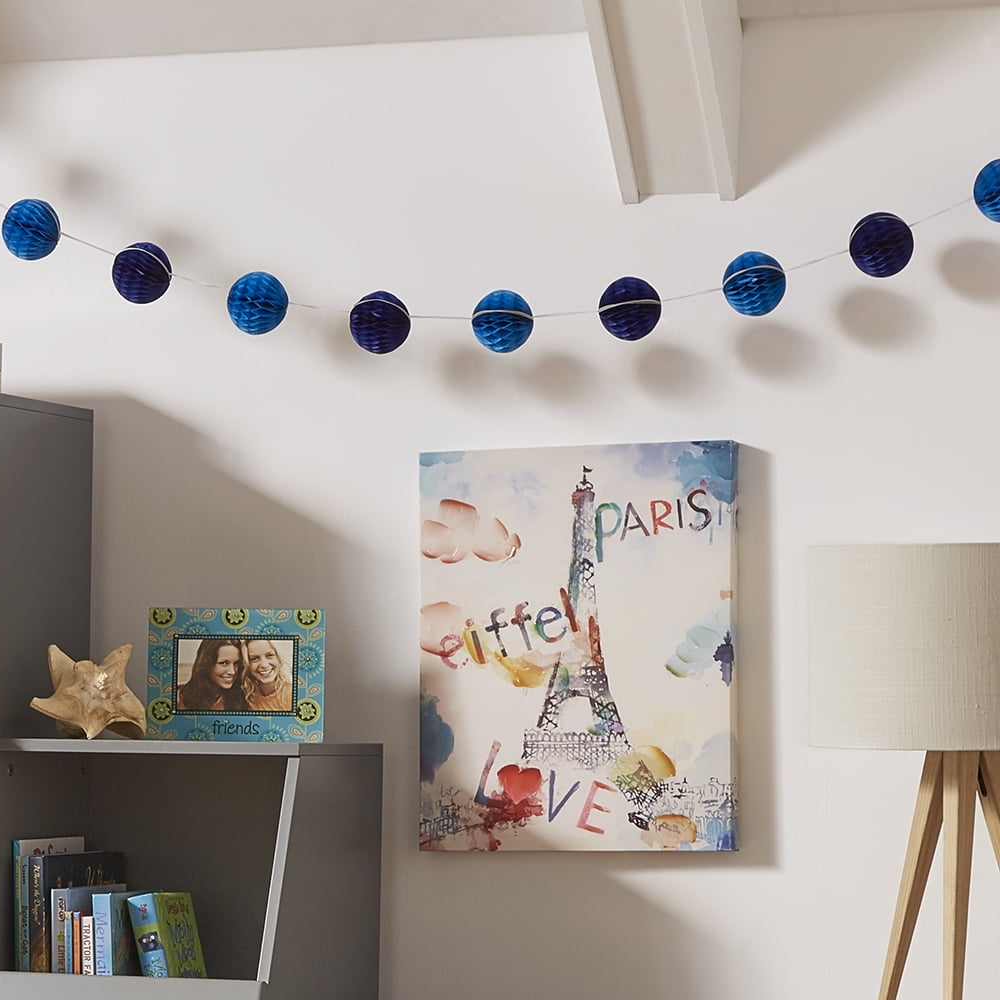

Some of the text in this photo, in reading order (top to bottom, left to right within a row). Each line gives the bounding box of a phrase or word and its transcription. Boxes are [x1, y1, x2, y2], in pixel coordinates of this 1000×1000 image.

[594, 489, 712, 563] PARIS
[440, 587, 578, 670] eiffel
[212, 720, 260, 735] friends
[83, 924, 91, 962] TRACTOR
[95, 911, 110, 975] Mermai
